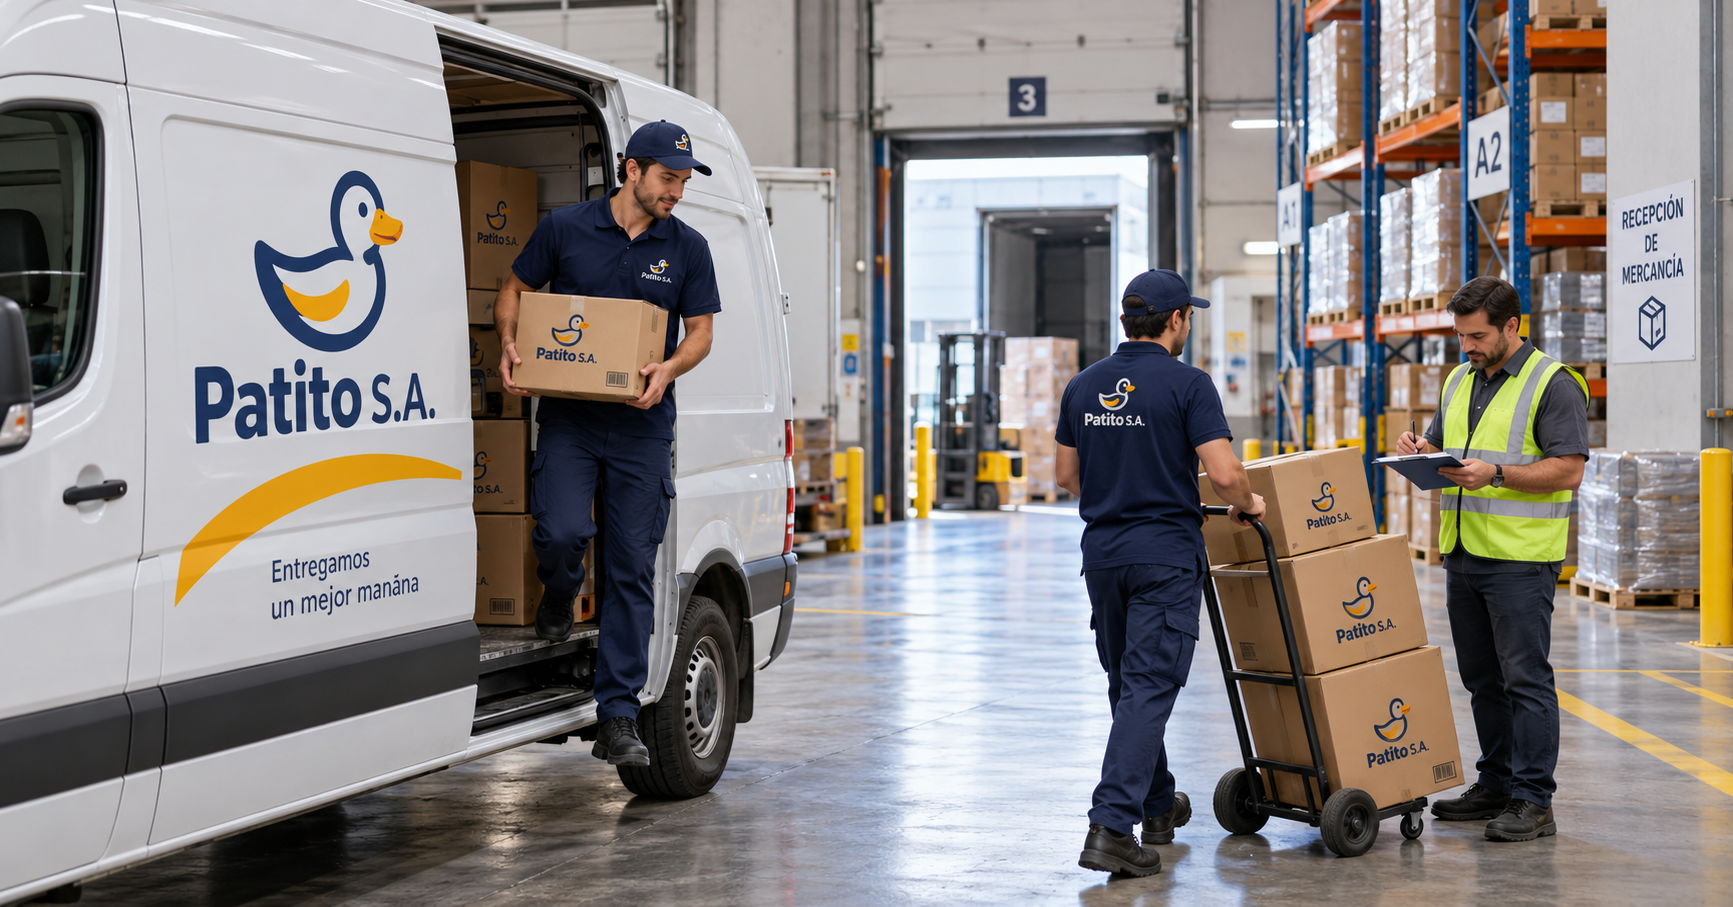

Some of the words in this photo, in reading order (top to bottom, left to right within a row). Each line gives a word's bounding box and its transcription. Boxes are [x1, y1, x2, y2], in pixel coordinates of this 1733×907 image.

[1018, 83, 1037, 112] 3
[1475, 131, 1502, 178] A2
[1282, 200, 1296, 232] A1
[1622, 194, 1684, 230] RECEPCIÓN
[477, 231, 505, 245] Patito
[1645, 233, 1658, 253] DE
[1622, 253, 1684, 285] MERCANCÍA
[536, 346, 577, 362] Patito
[578, 352, 597, 364] S.A.
[195, 358, 362, 444] Patito
[371, 372, 436, 424] S.A.
[1084, 412, 1125, 426] Patito
[1125, 415, 1146, 427] S.A.
[485, 484, 504, 494] S.A.
[1306, 514, 1337, 530] Patito
[1337, 511, 1352, 523] S.A.
[272, 551, 370, 583] Entregamos
[271, 598, 294, 620] un
[301, 585, 352, 616] mejor
[1336, 622, 1376, 644] Patito
[1377, 618, 1397, 632] S.A.
[1366, 746, 1408, 768] Patito
[1409, 740, 1430, 756] S.A.
